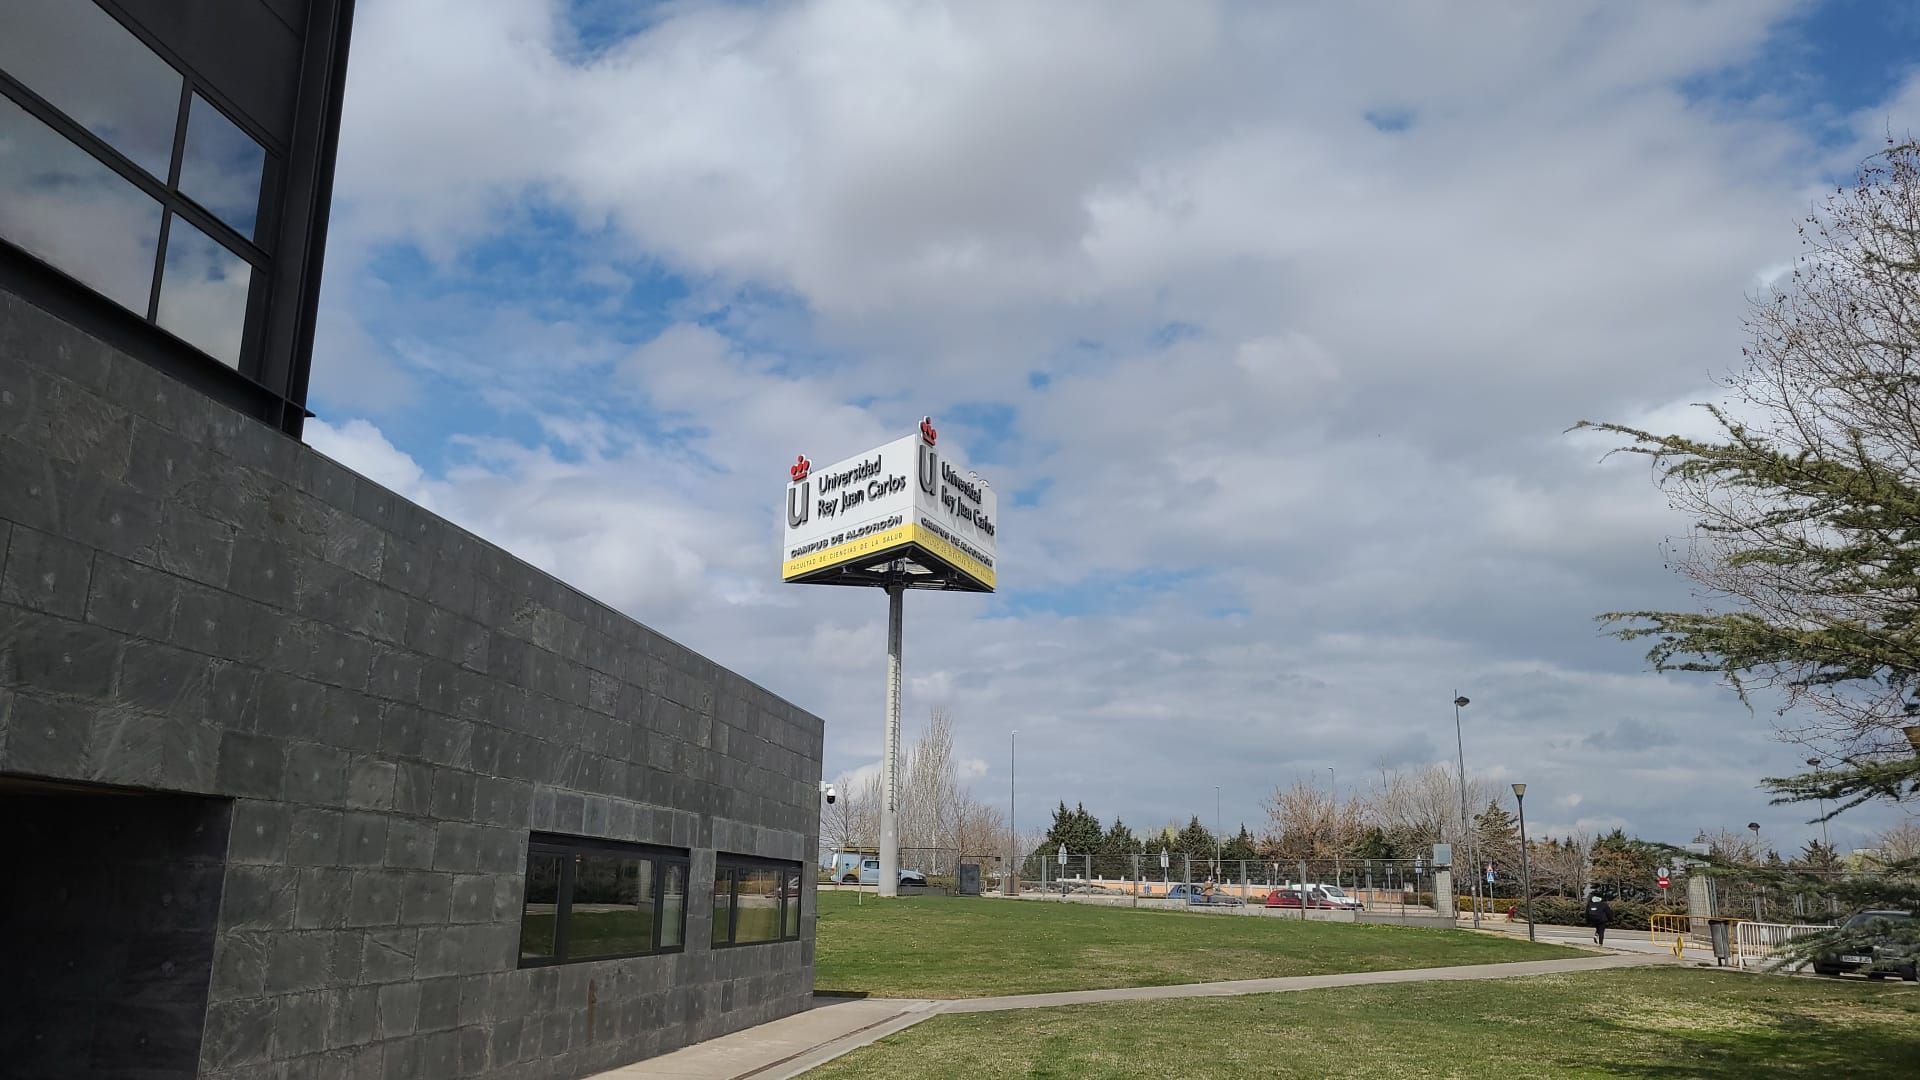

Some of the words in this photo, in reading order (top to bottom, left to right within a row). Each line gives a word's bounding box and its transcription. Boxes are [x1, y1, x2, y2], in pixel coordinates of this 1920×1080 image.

[819, 454, 882, 495] Universidad
[941, 460, 982, 504] Universidad
[818, 498, 838, 520] Rey
[840, 490, 864, 515] Juan
[867, 474, 906, 501] Carlos
[941, 485, 956, 514] Rey
[956, 496, 972, 521] Juan
[972, 508, 995, 536] Carlos
[790, 539, 829, 559] CAMPUS
[831, 533, 844, 547] DE
[790, 558, 816, 571] FACULTAD
[819, 555, 826, 563] DE
[829, 547, 857, 560] CIENCIAS
[860, 543, 868, 551] DE
[871, 539, 879, 547] LA
[882, 532, 903, 543] SALUD
[950, 534, 961, 546] DE
